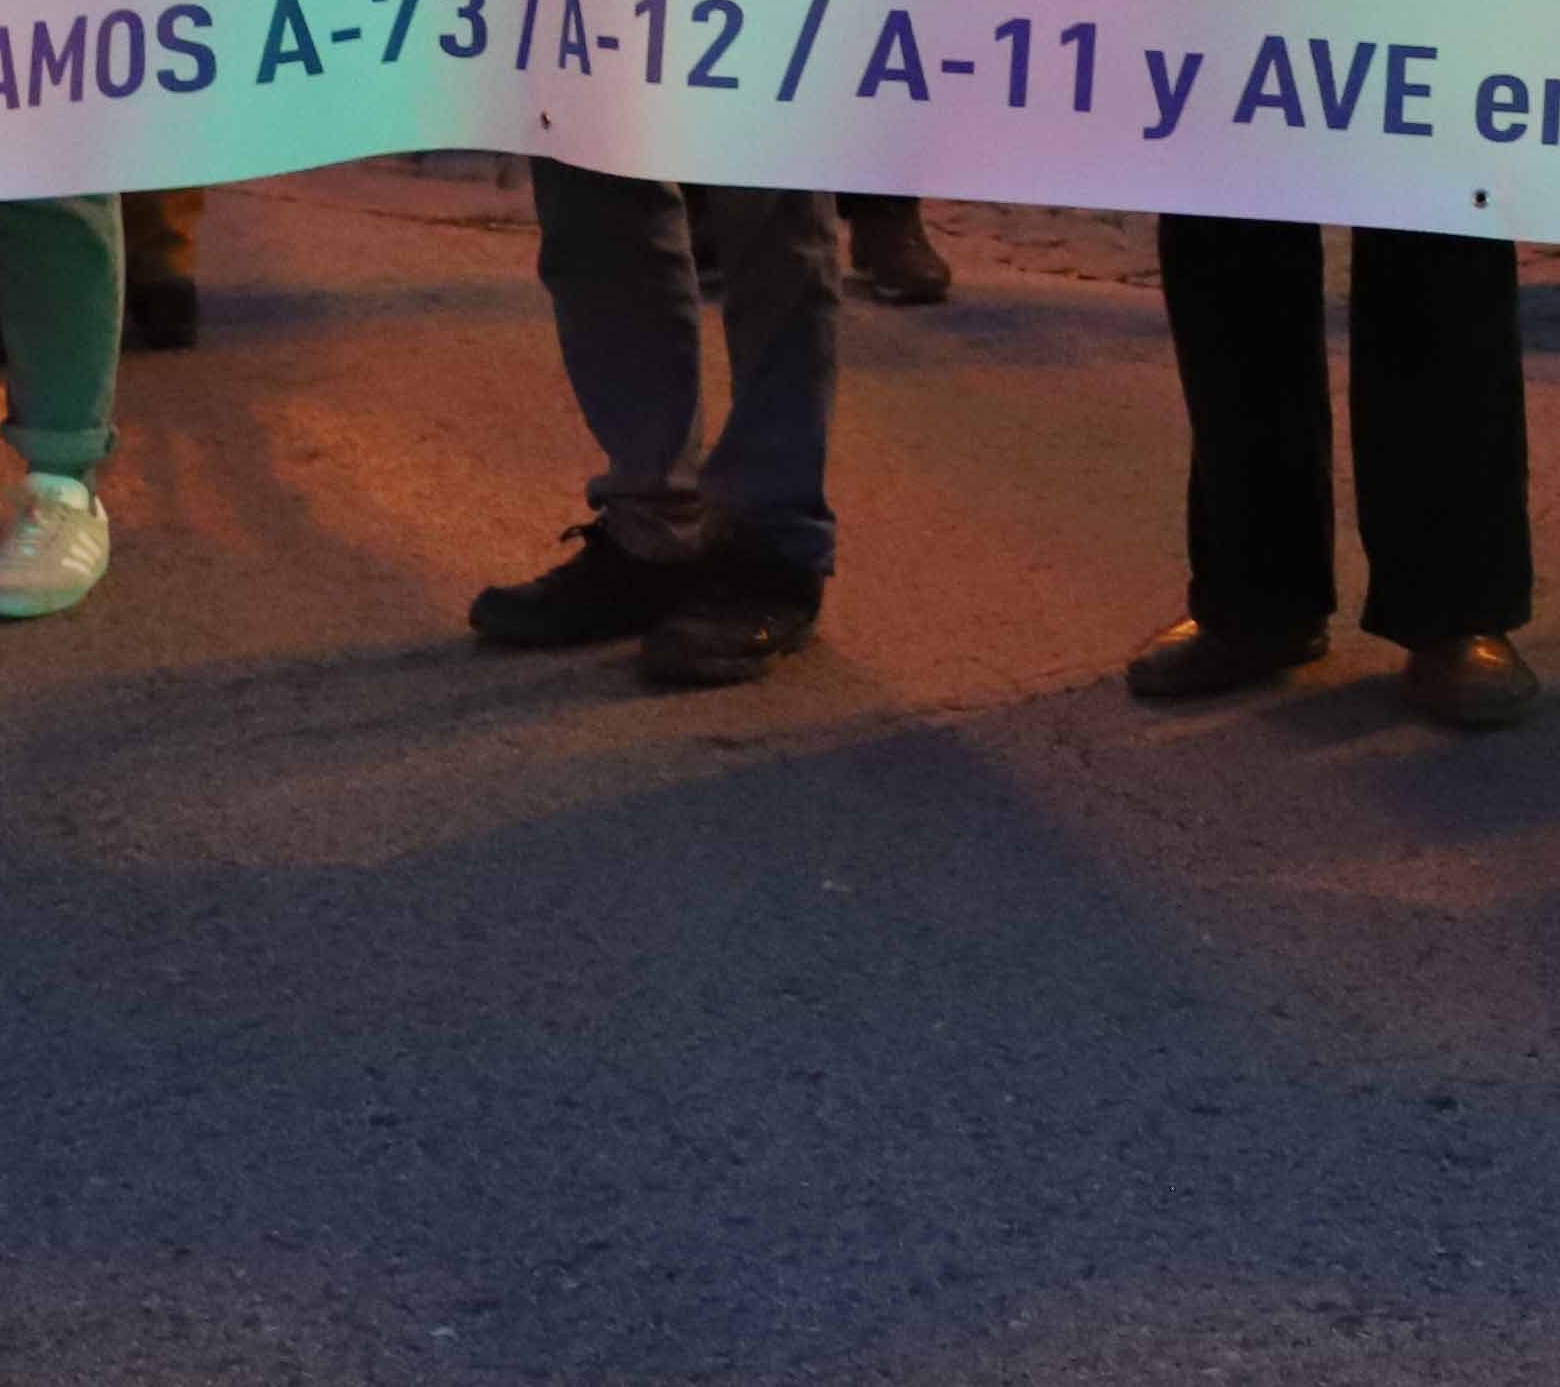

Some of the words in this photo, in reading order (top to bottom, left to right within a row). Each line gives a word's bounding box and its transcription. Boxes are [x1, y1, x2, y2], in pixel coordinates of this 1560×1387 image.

[854, 8, 1098, 114] A-11
[1142, 48, 1206, 141] y
[1230, 33, 1440, 138] AVE
